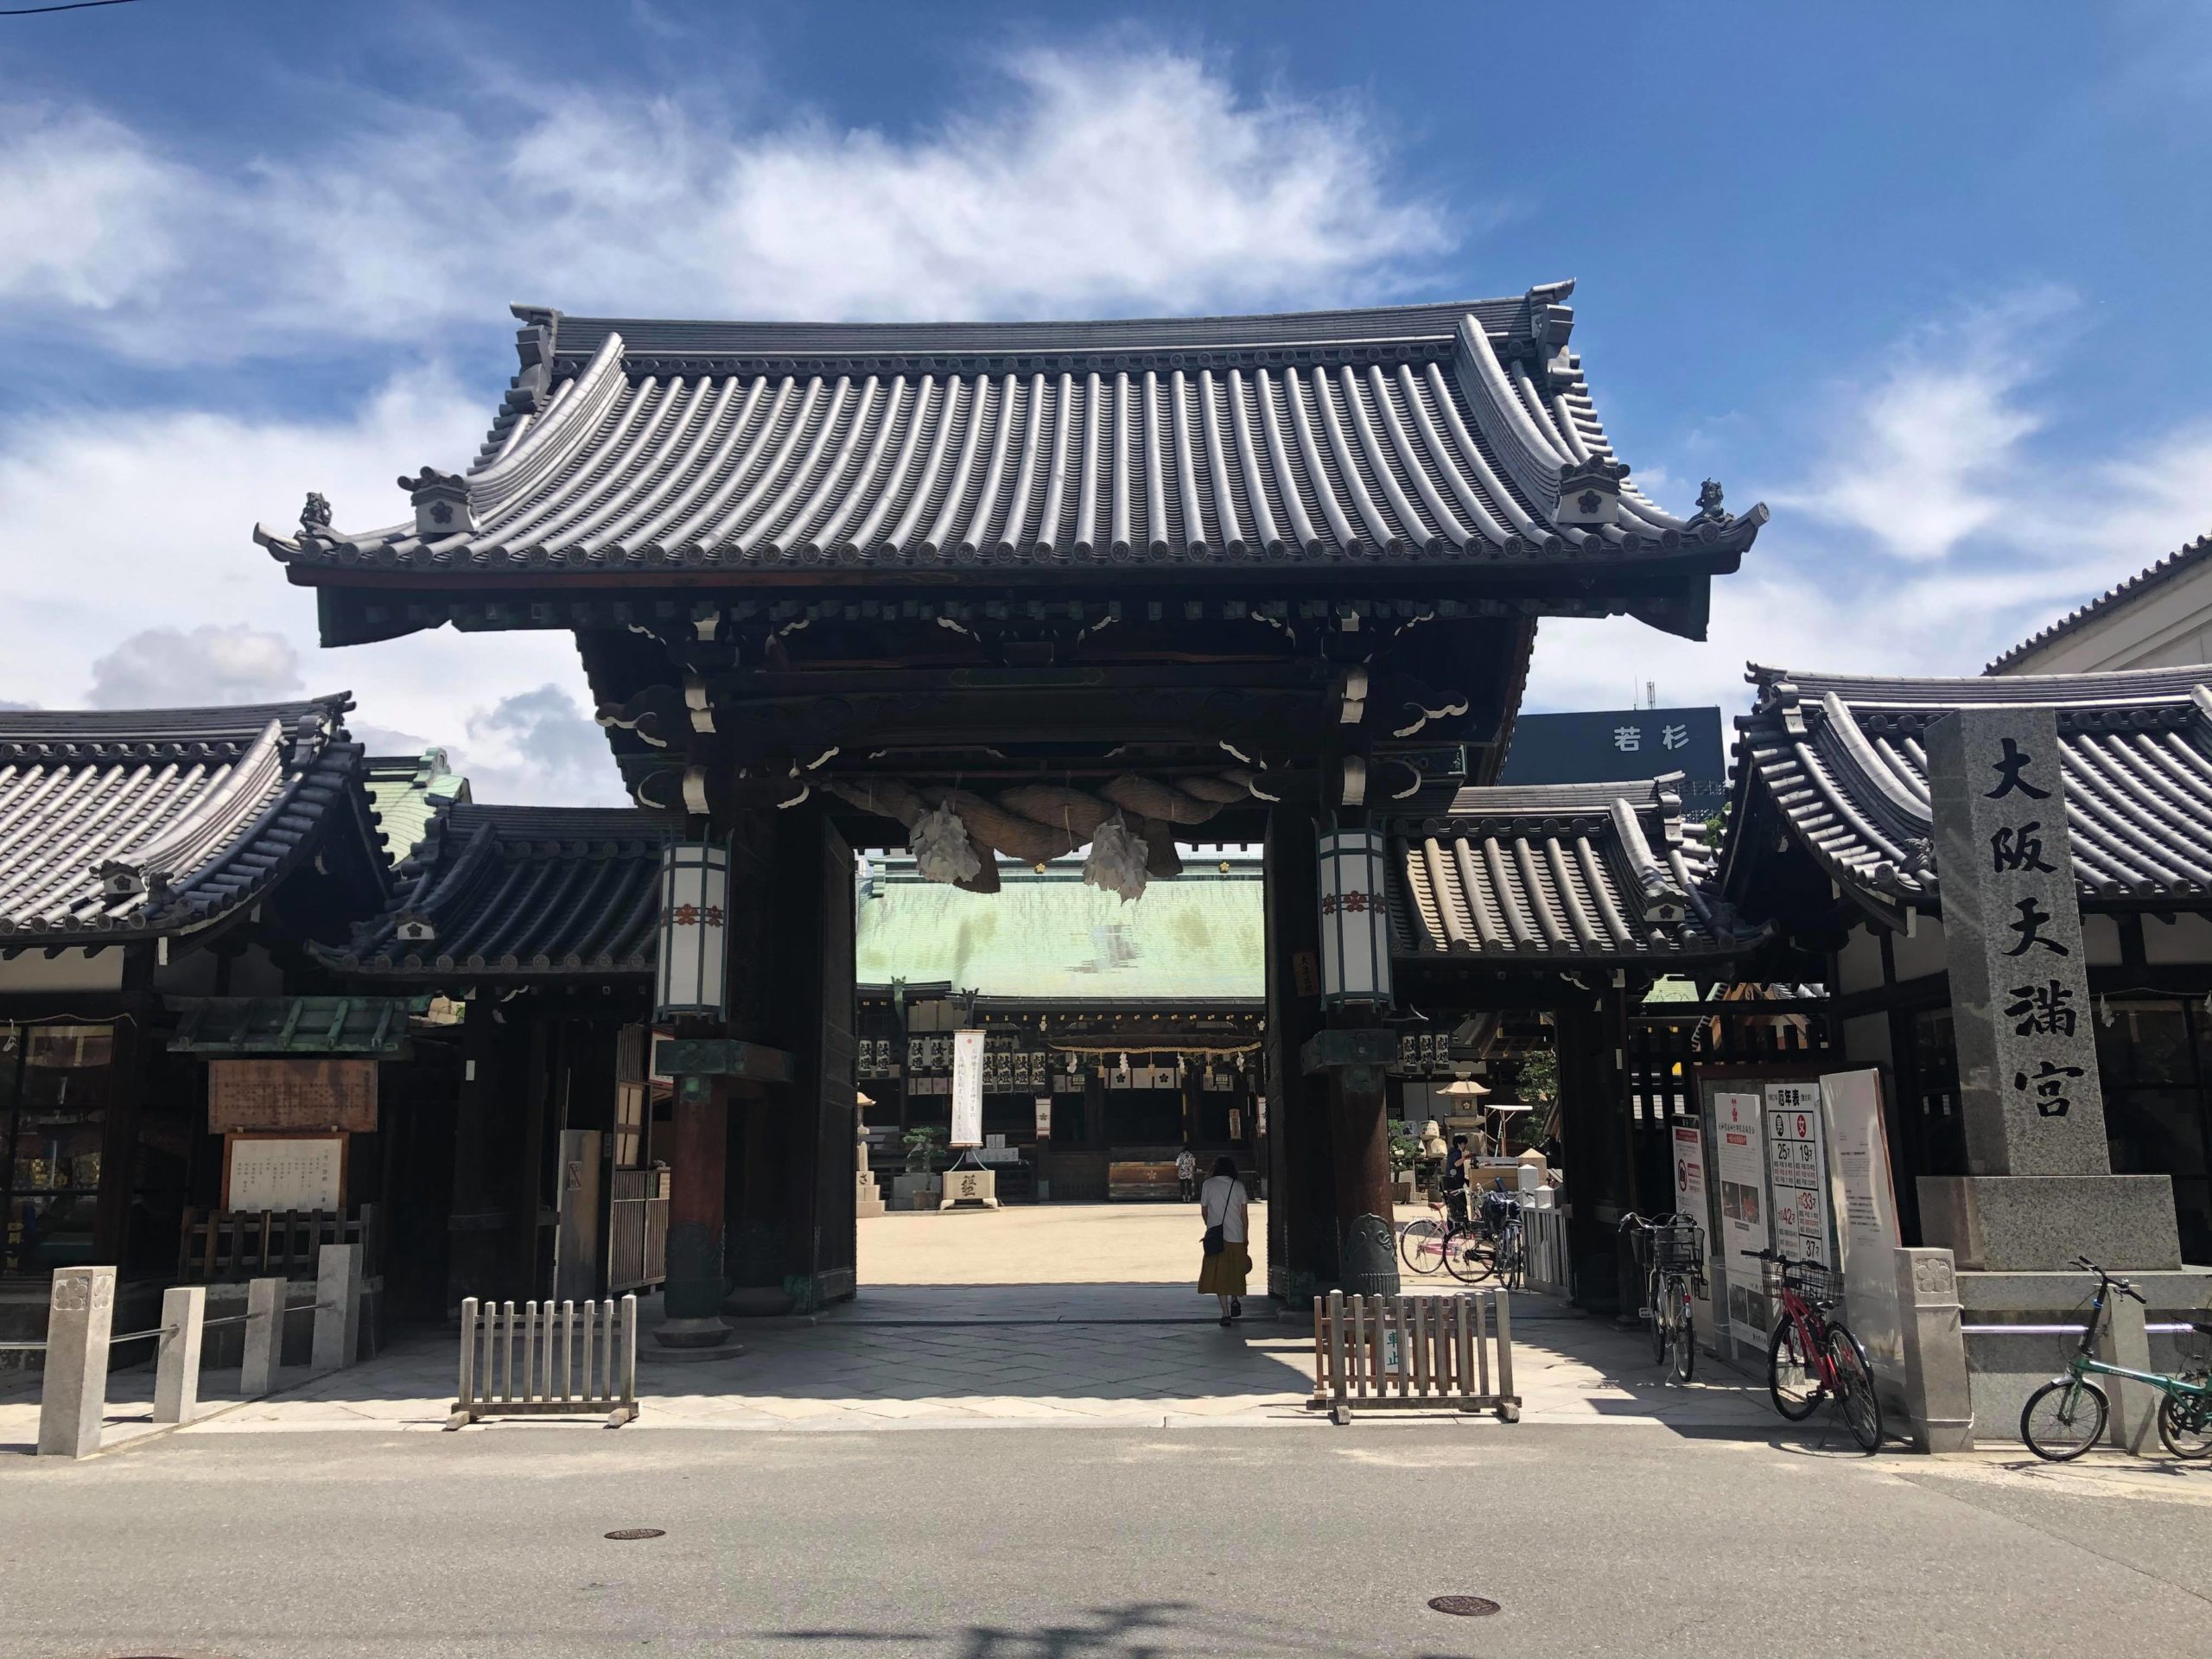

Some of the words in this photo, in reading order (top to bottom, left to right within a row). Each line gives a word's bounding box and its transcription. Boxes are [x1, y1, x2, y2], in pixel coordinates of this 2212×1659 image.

[1613, 723, 1690, 752] 若杉
[1982, 737, 2085, 1118] 大阪天満宮
[1778, 1089, 1800, 1107] 厄年表
